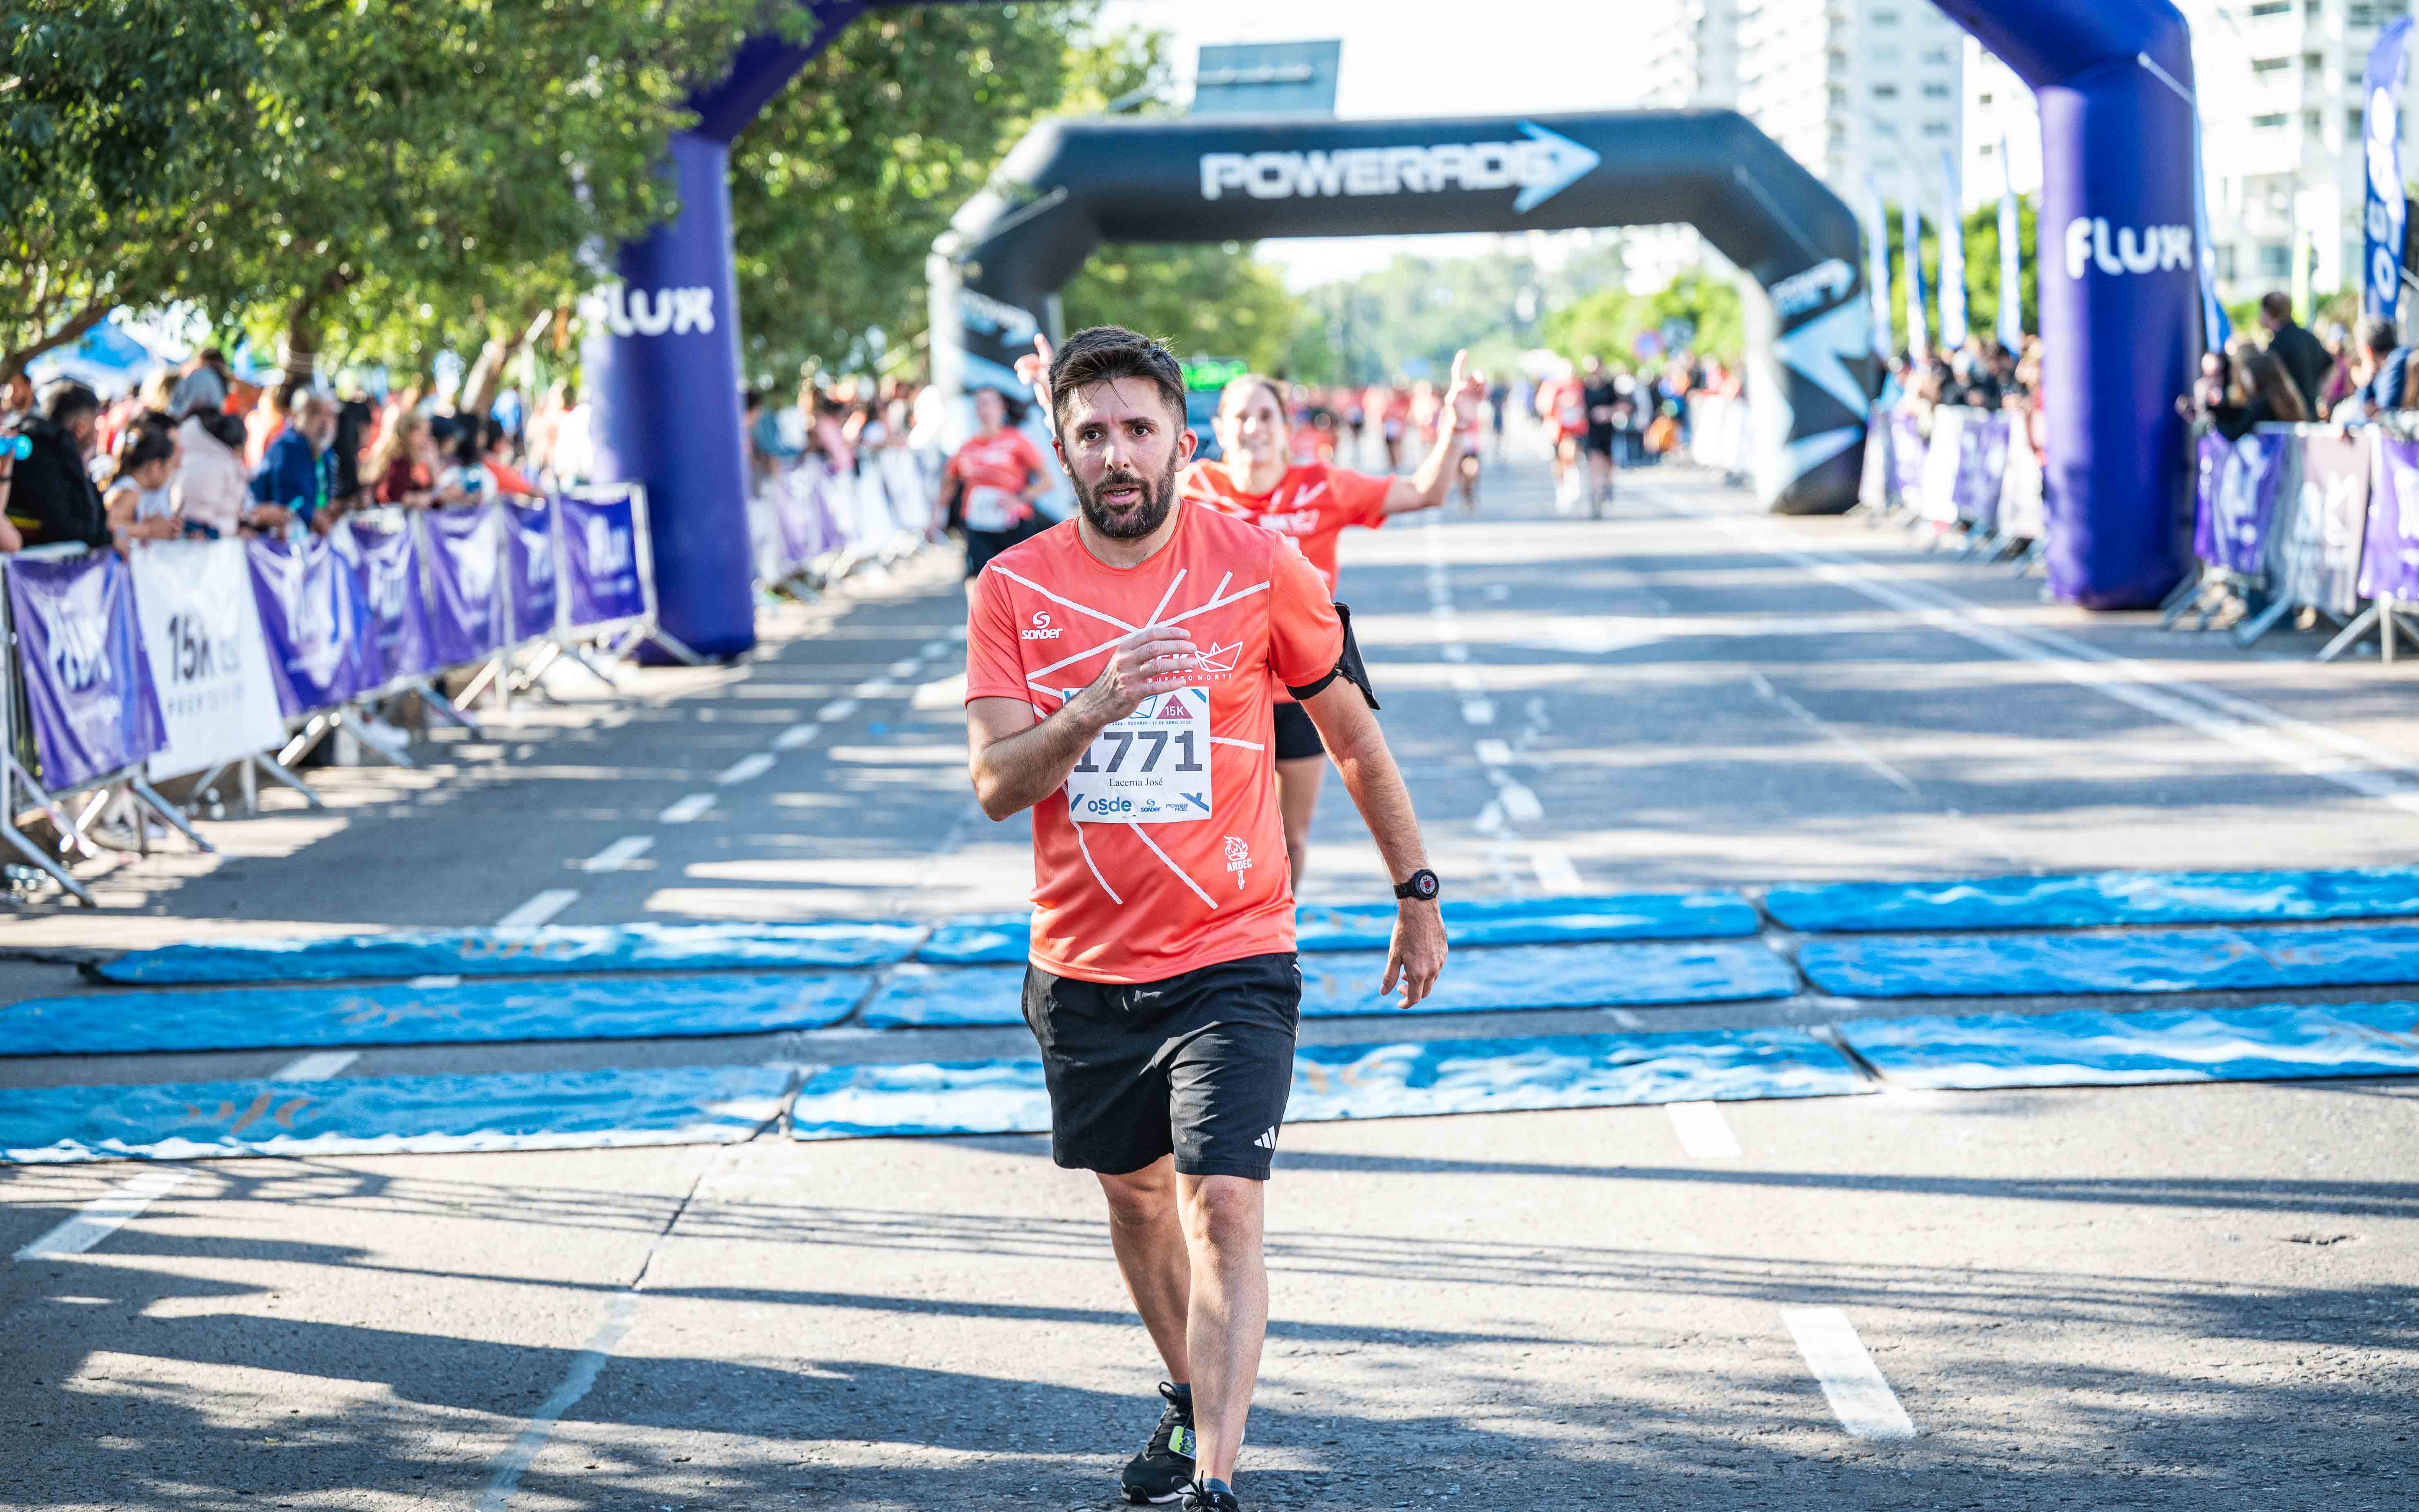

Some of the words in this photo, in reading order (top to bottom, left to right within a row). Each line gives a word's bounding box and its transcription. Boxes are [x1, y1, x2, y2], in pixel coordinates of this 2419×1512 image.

[588, 282, 714, 337] lux
[1165, 706, 1184, 716] 15K
[1109, 778, 1142, 787] Lacerna
[1145, 777, 1163, 786] José
[1087, 796, 1132, 813] osde
[1226, 857, 1253, 873] ARDEC
